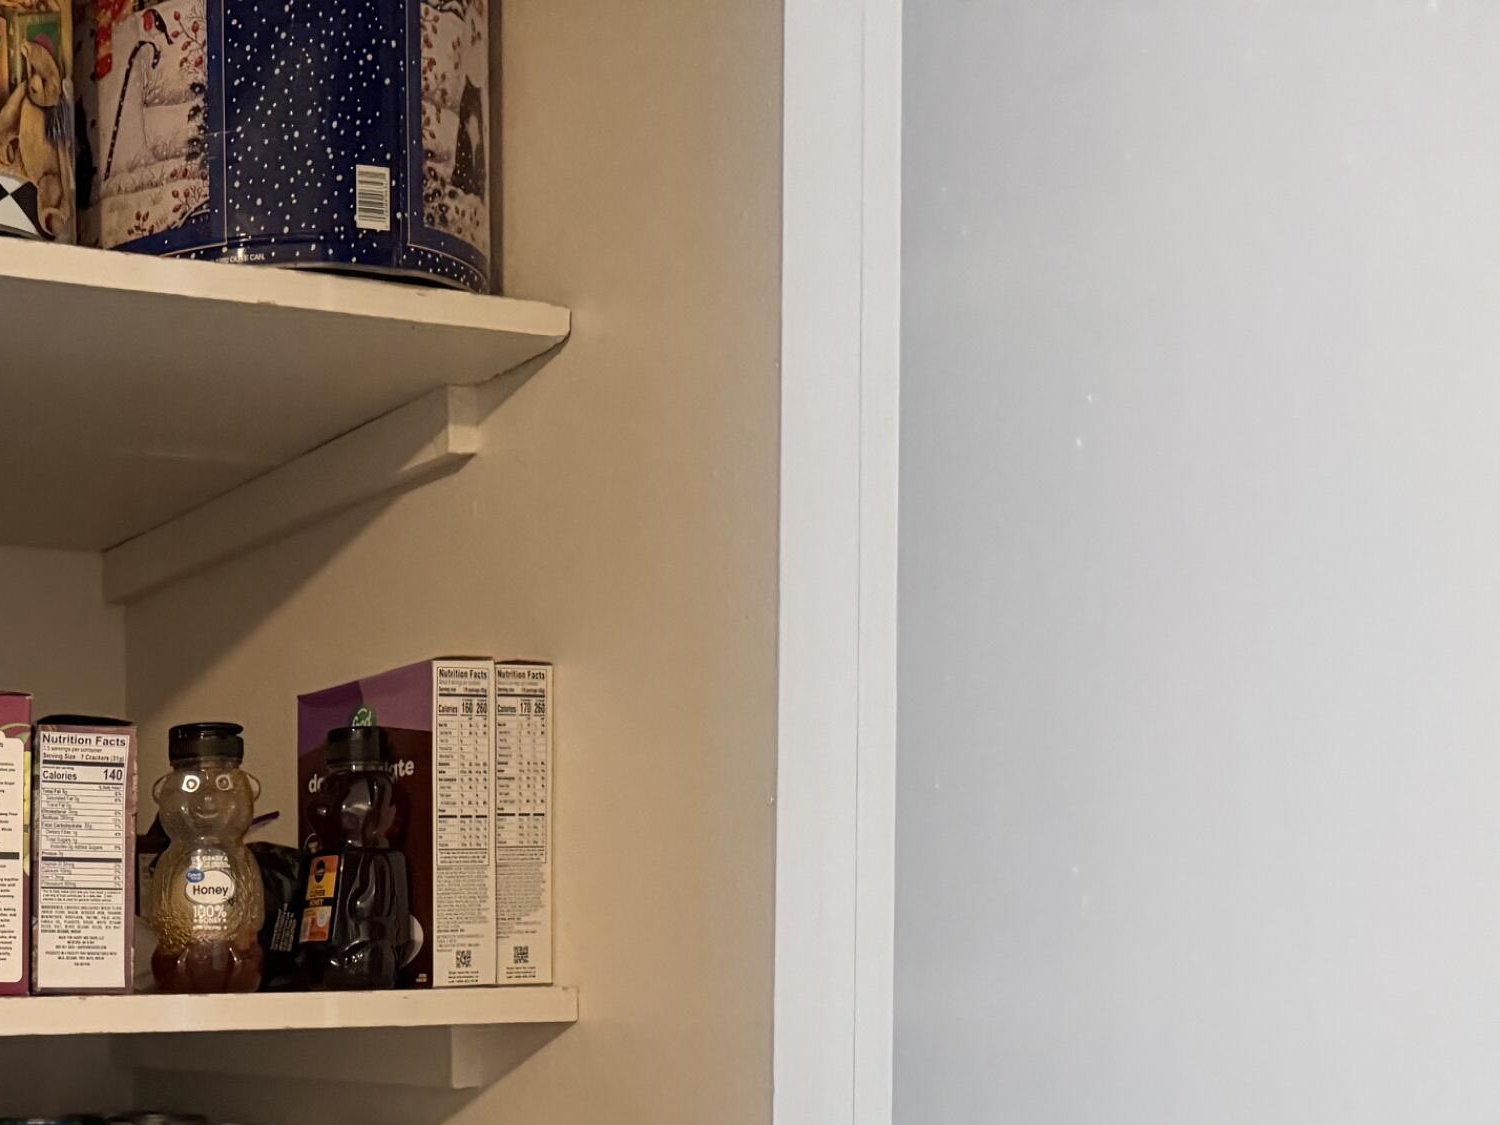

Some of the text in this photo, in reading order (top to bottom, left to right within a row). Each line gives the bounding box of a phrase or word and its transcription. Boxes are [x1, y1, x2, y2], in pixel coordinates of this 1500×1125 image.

[439, 668, 488, 680] Nutrition Facts
[497, 669, 545, 680] Nutrition Facts
[42, 733, 126, 747] Nutrition Facts
[42, 769, 123, 781] Calories 140
[192, 884, 229, 896] Honey
[192, 904, 227, 918] 100%
